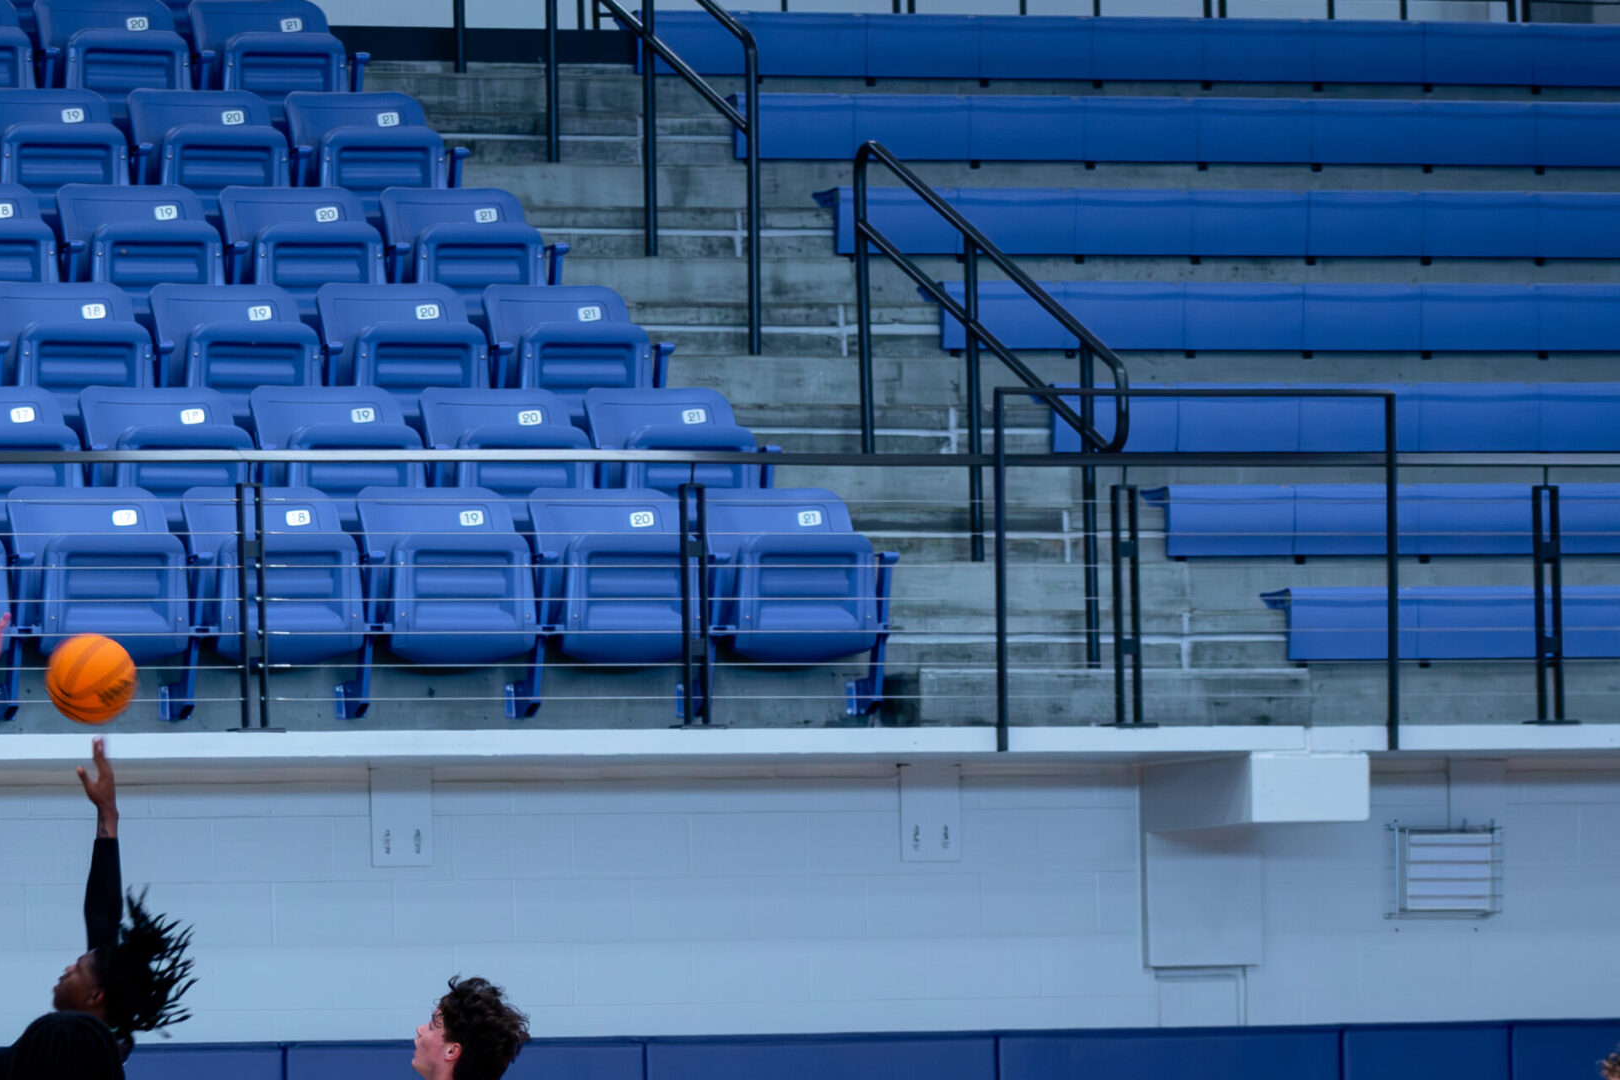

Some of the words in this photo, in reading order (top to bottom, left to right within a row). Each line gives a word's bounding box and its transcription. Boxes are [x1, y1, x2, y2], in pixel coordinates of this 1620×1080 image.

[130, 18, 146, 29] 20
[285, 20, 298, 31] 21
[66, 110, 80, 121] 19
[225, 112, 241, 123] 20
[381, 114, 395, 125] 21
[159, 207, 173, 218] 19
[319, 209, 336, 220] 20
[479, 210, 493, 221] 21
[86, 306, 101, 317] 18
[253, 307, 267, 319] 19
[419, 306, 436, 318] 20
[583, 308, 596, 320] 21
[356, 410, 370, 421] 19
[522, 412, 539, 424] 20
[686, 411, 701, 422] 21
[464, 512, 479, 524] 19
[633, 513, 651, 525] 20
[803, 512, 817, 524] 21
